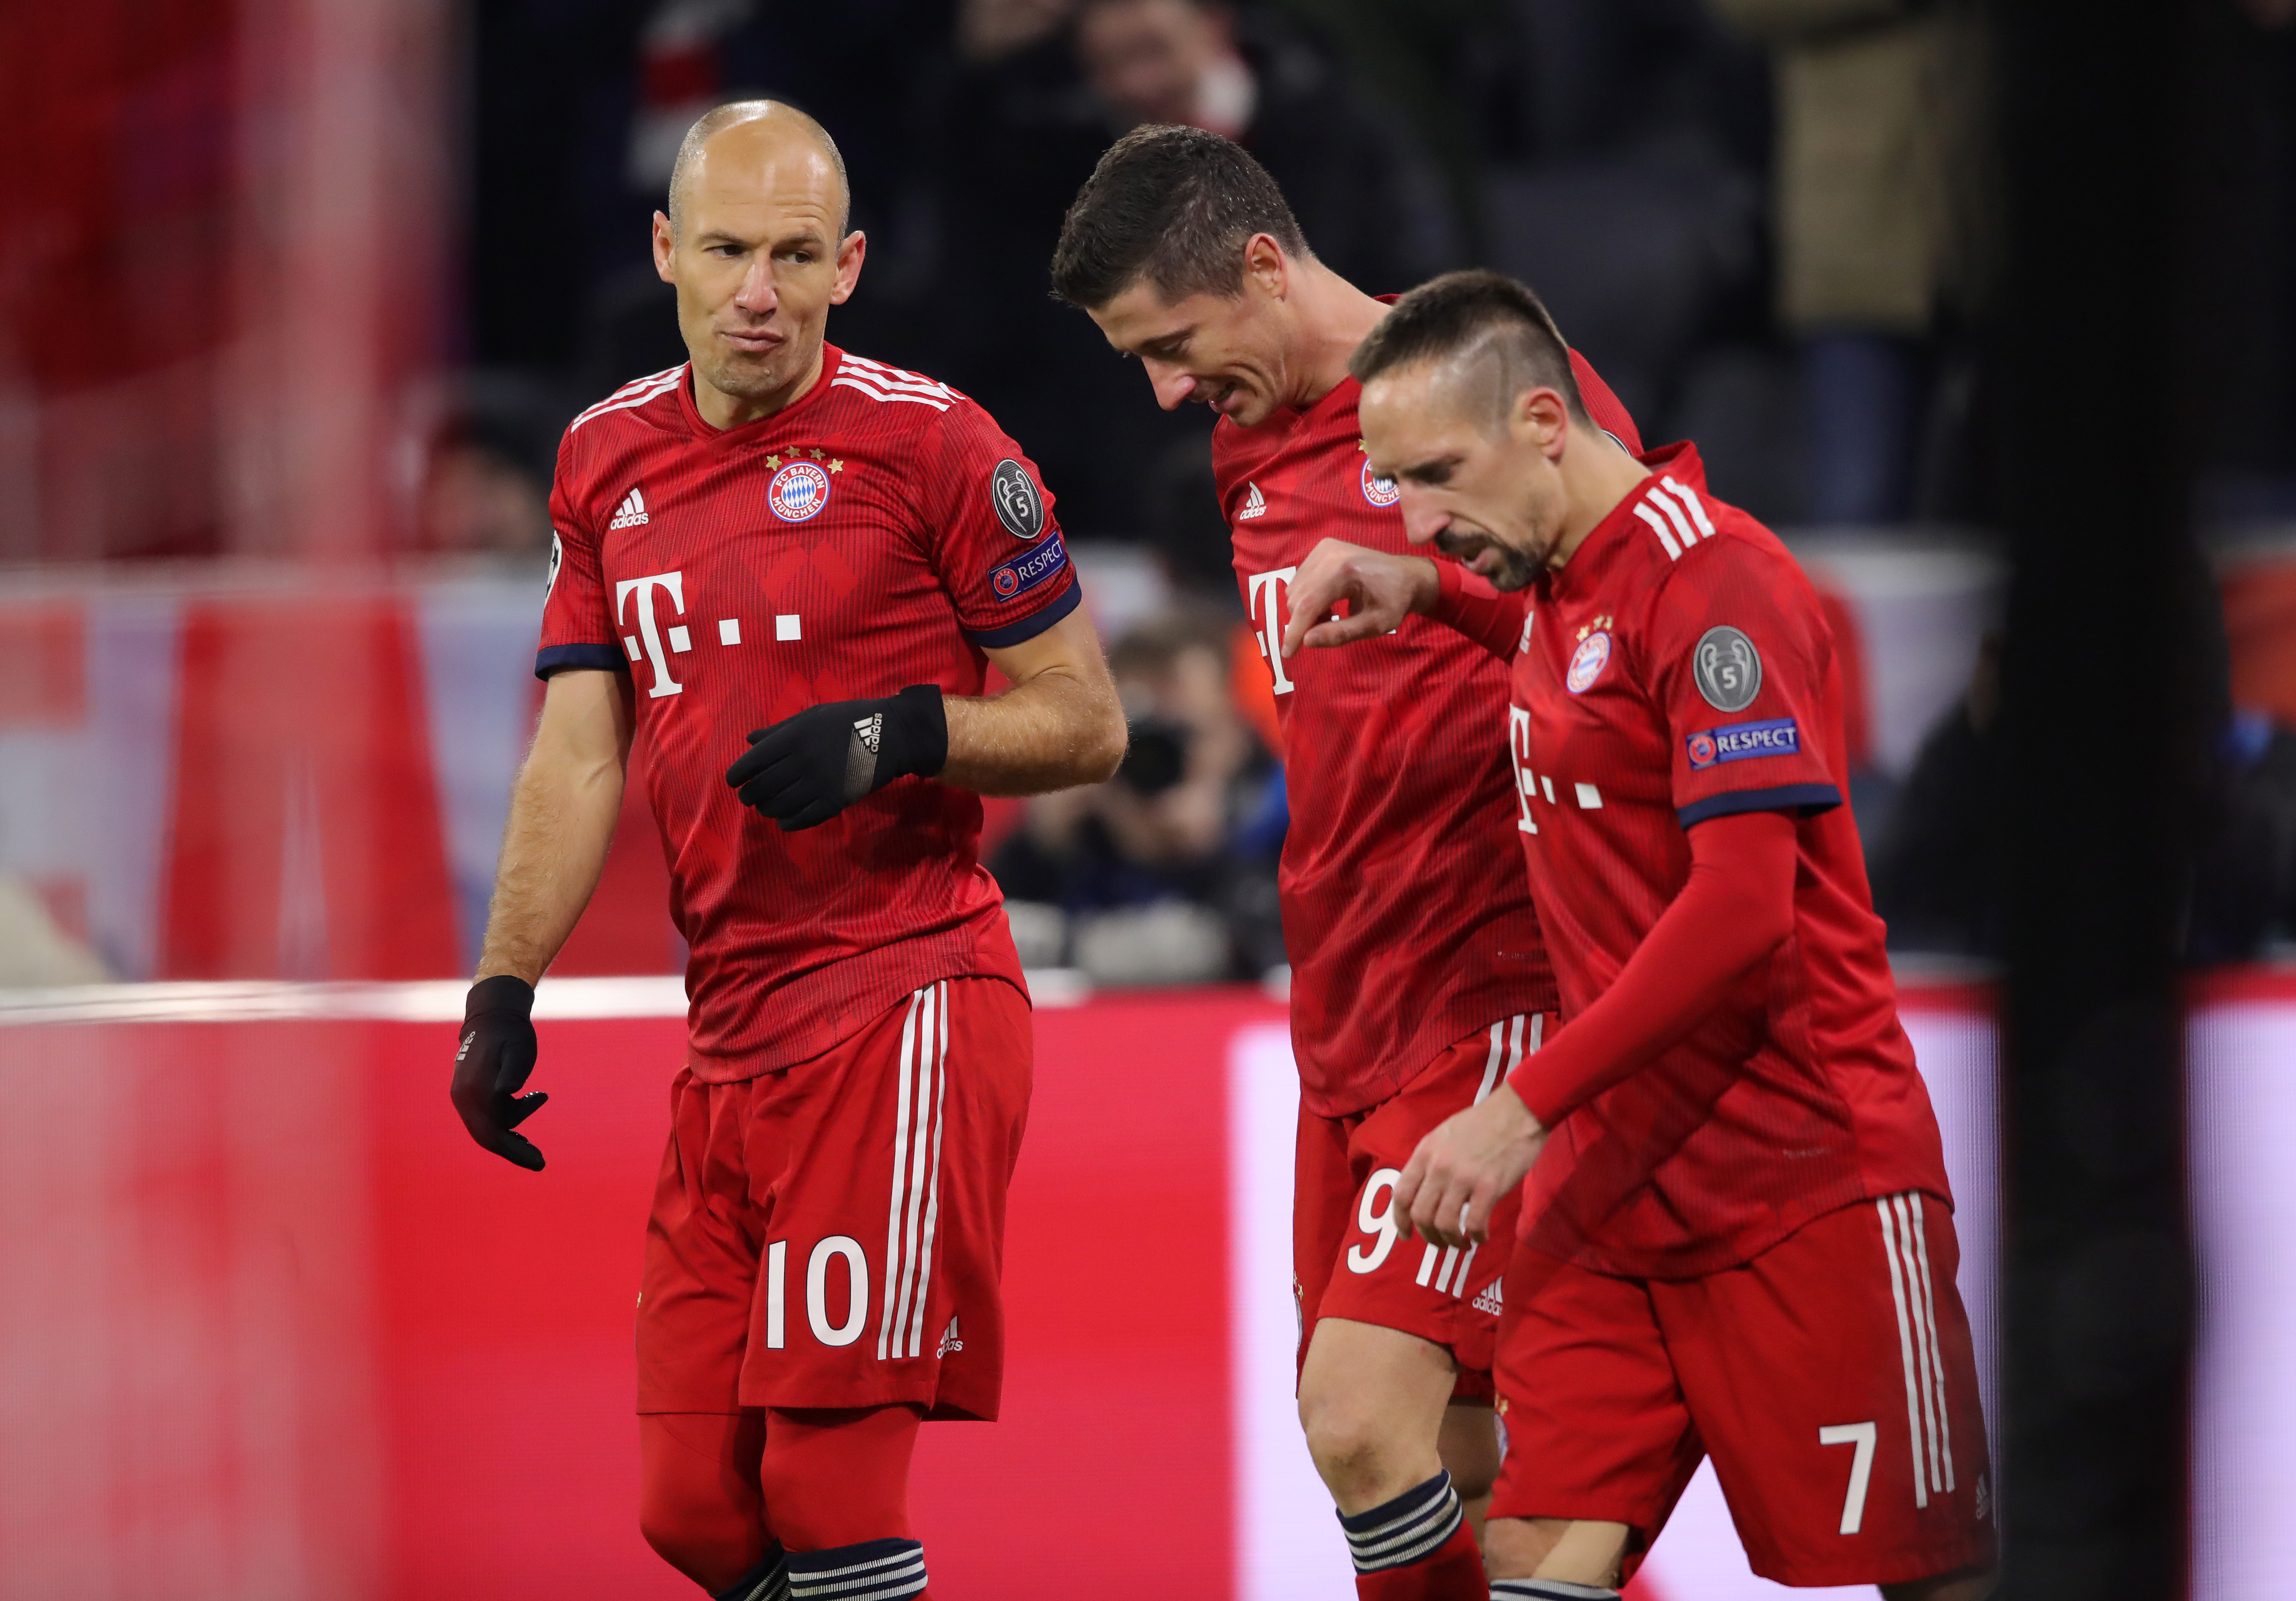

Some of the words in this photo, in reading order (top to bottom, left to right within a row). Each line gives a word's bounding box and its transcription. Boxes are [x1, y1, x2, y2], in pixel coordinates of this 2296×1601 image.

[775, 474, 788, 487] FC
[790, 467, 825, 489] BAYERN
[1365, 482, 1400, 502] MÜNCHE
[772, 496, 821, 518] MÜNCHEN
[1016, 497, 1028, 517] 5
[1239, 505, 1267, 520] adidas
[610, 513, 649, 530] adidas
[1018, 540, 1063, 581] RESPECT
[997, 570, 1010, 579] UEFA
[1722, 667, 1737, 689] 5
[870, 713, 883, 752] adidas
[1717, 727, 1795, 753] RESPECT
[1347, 1167, 1402, 1274] 9
[766, 1235, 869, 1349] 10
[1819, 1421, 1877, 1535] 7
